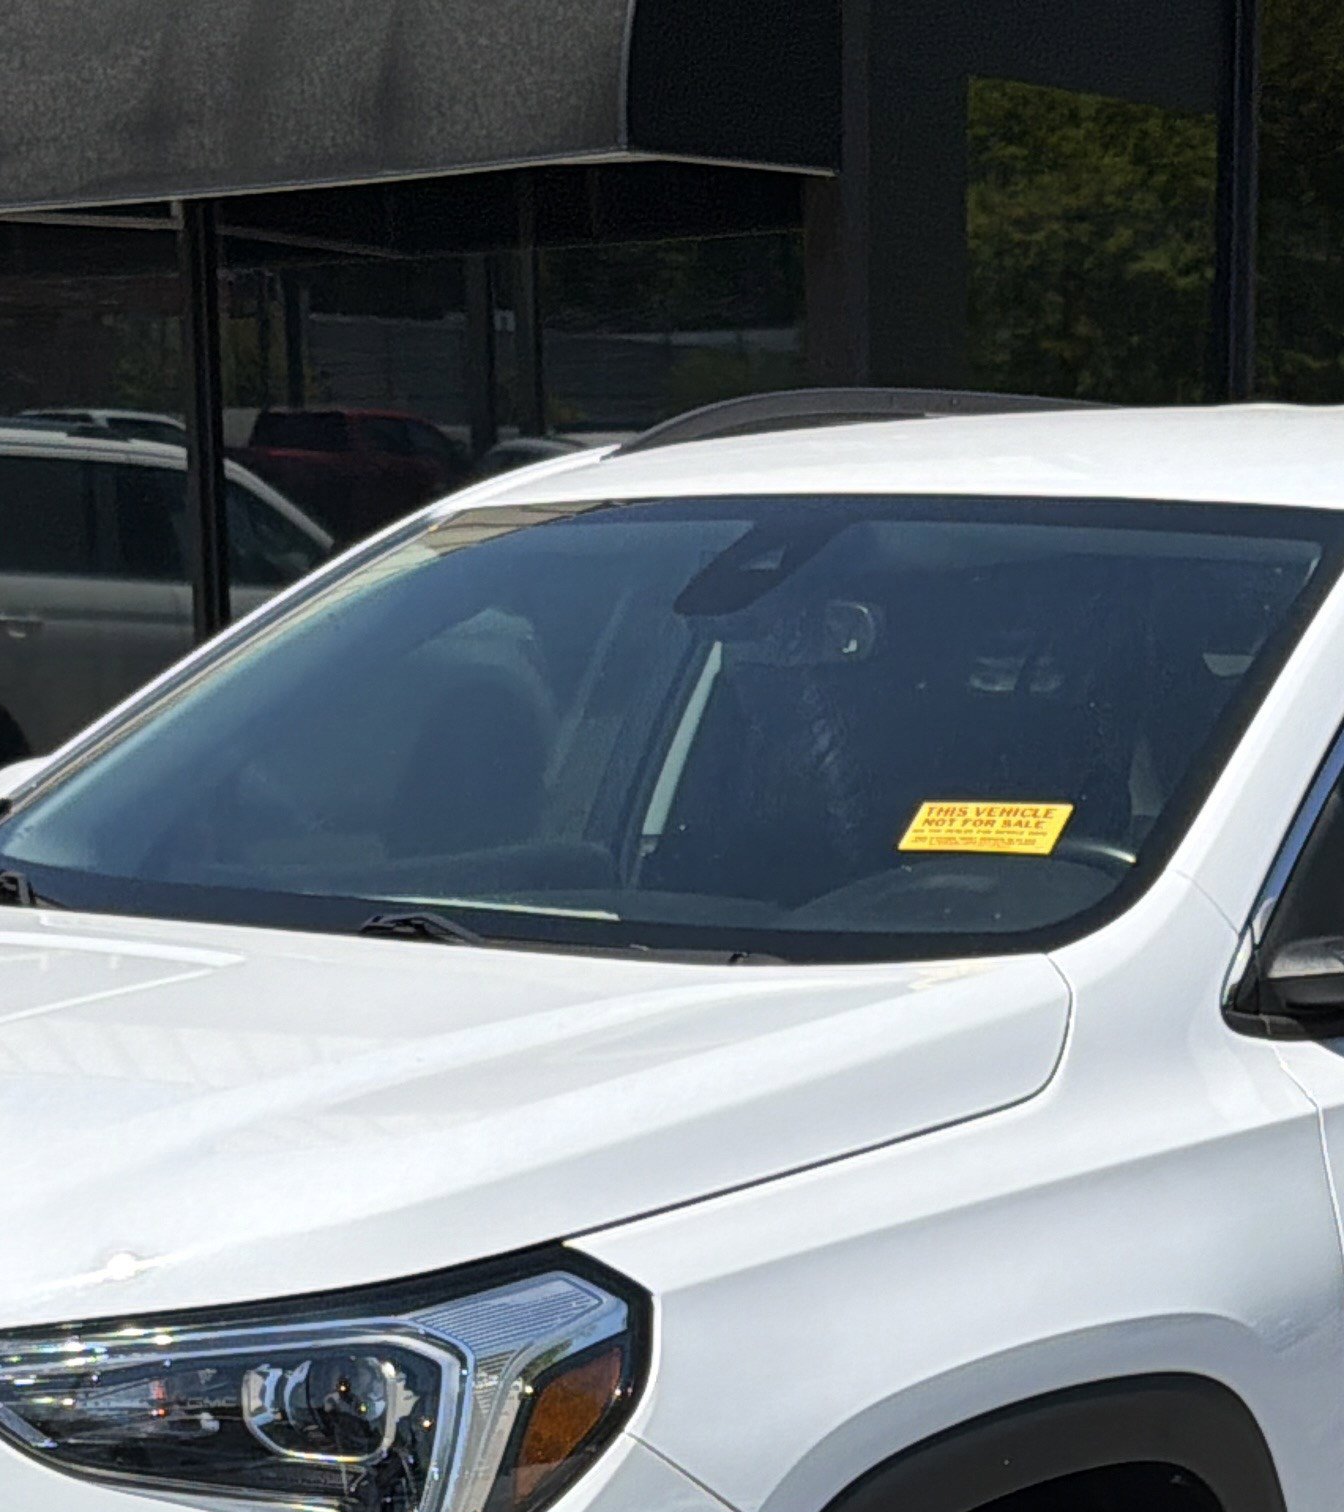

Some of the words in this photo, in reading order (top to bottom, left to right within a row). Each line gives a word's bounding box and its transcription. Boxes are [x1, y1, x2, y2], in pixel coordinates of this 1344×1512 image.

[926, 806, 969, 818] THIS
[975, 806, 1056, 819] VEHICLE
[922, 817, 957, 828] NOT
[962, 818, 997, 829] FOR
[1001, 819, 1047, 829] SALE
